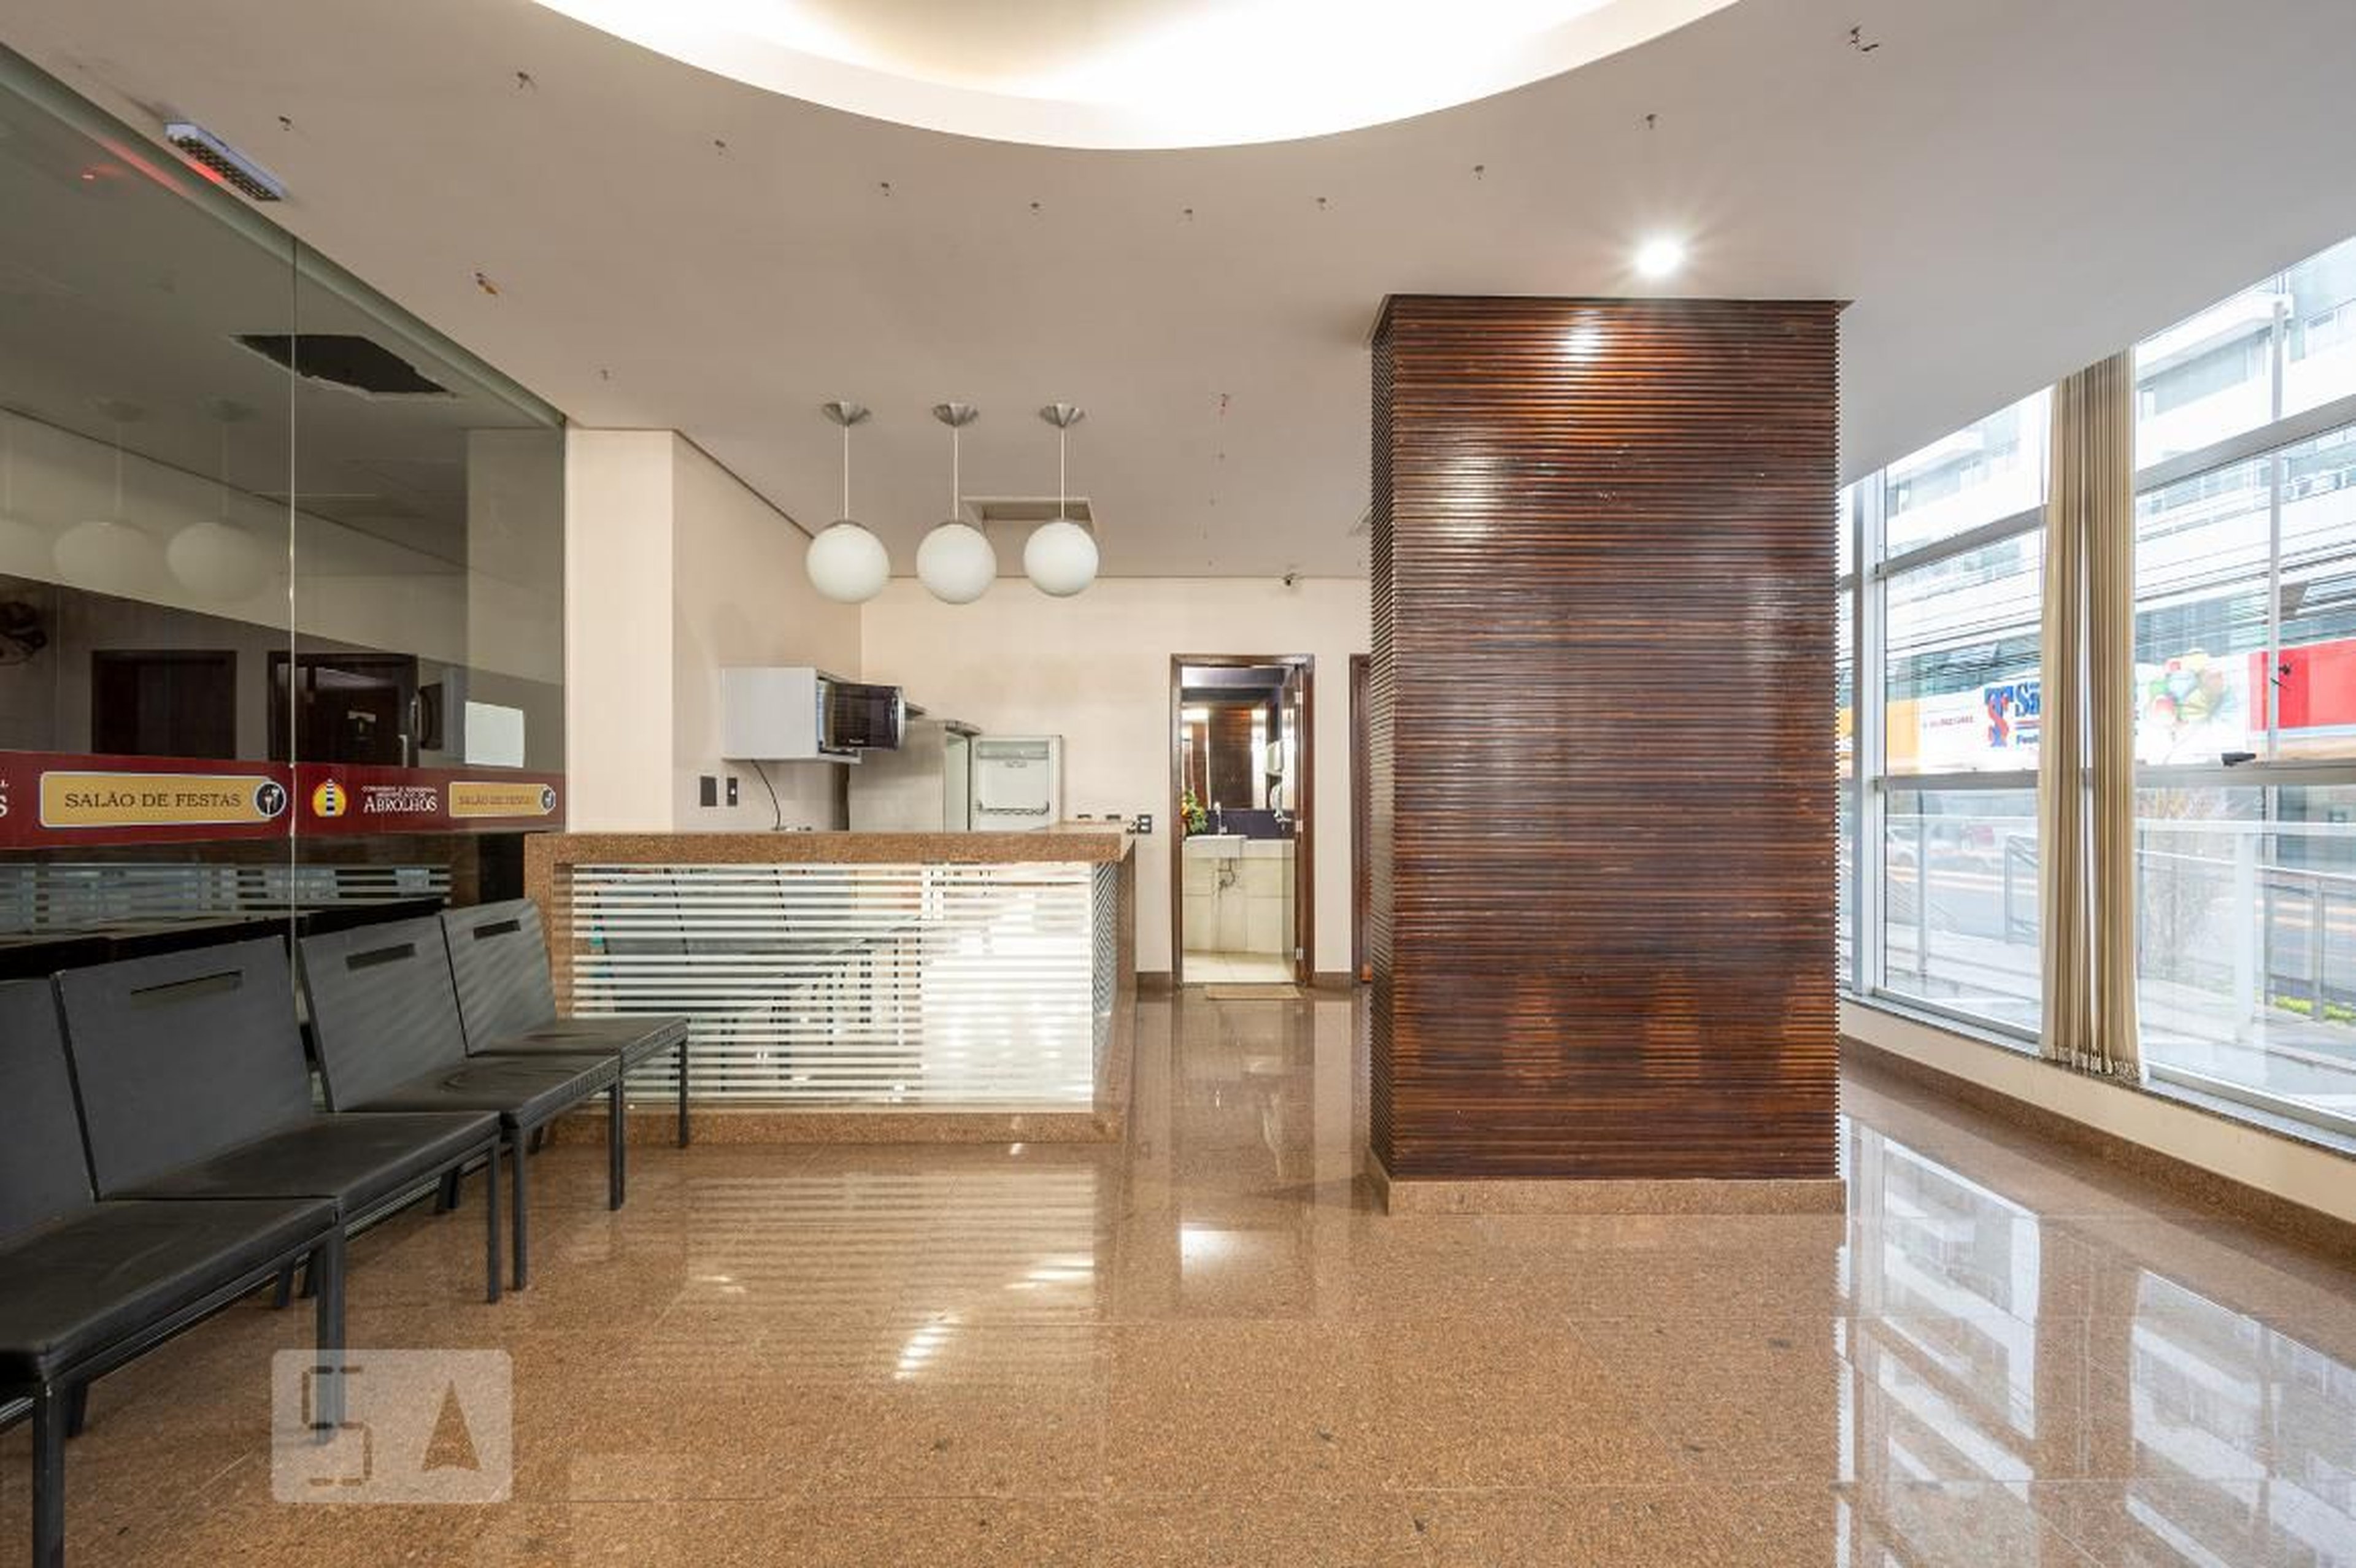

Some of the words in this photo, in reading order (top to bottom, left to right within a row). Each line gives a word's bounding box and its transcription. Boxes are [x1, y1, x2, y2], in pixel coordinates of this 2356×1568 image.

[65, 792, 135, 807] SALÃO
[141, 793, 169, 807] DE
[175, 793, 241, 807] FESTAS
[363, 796, 437, 813] ABROLHOS
